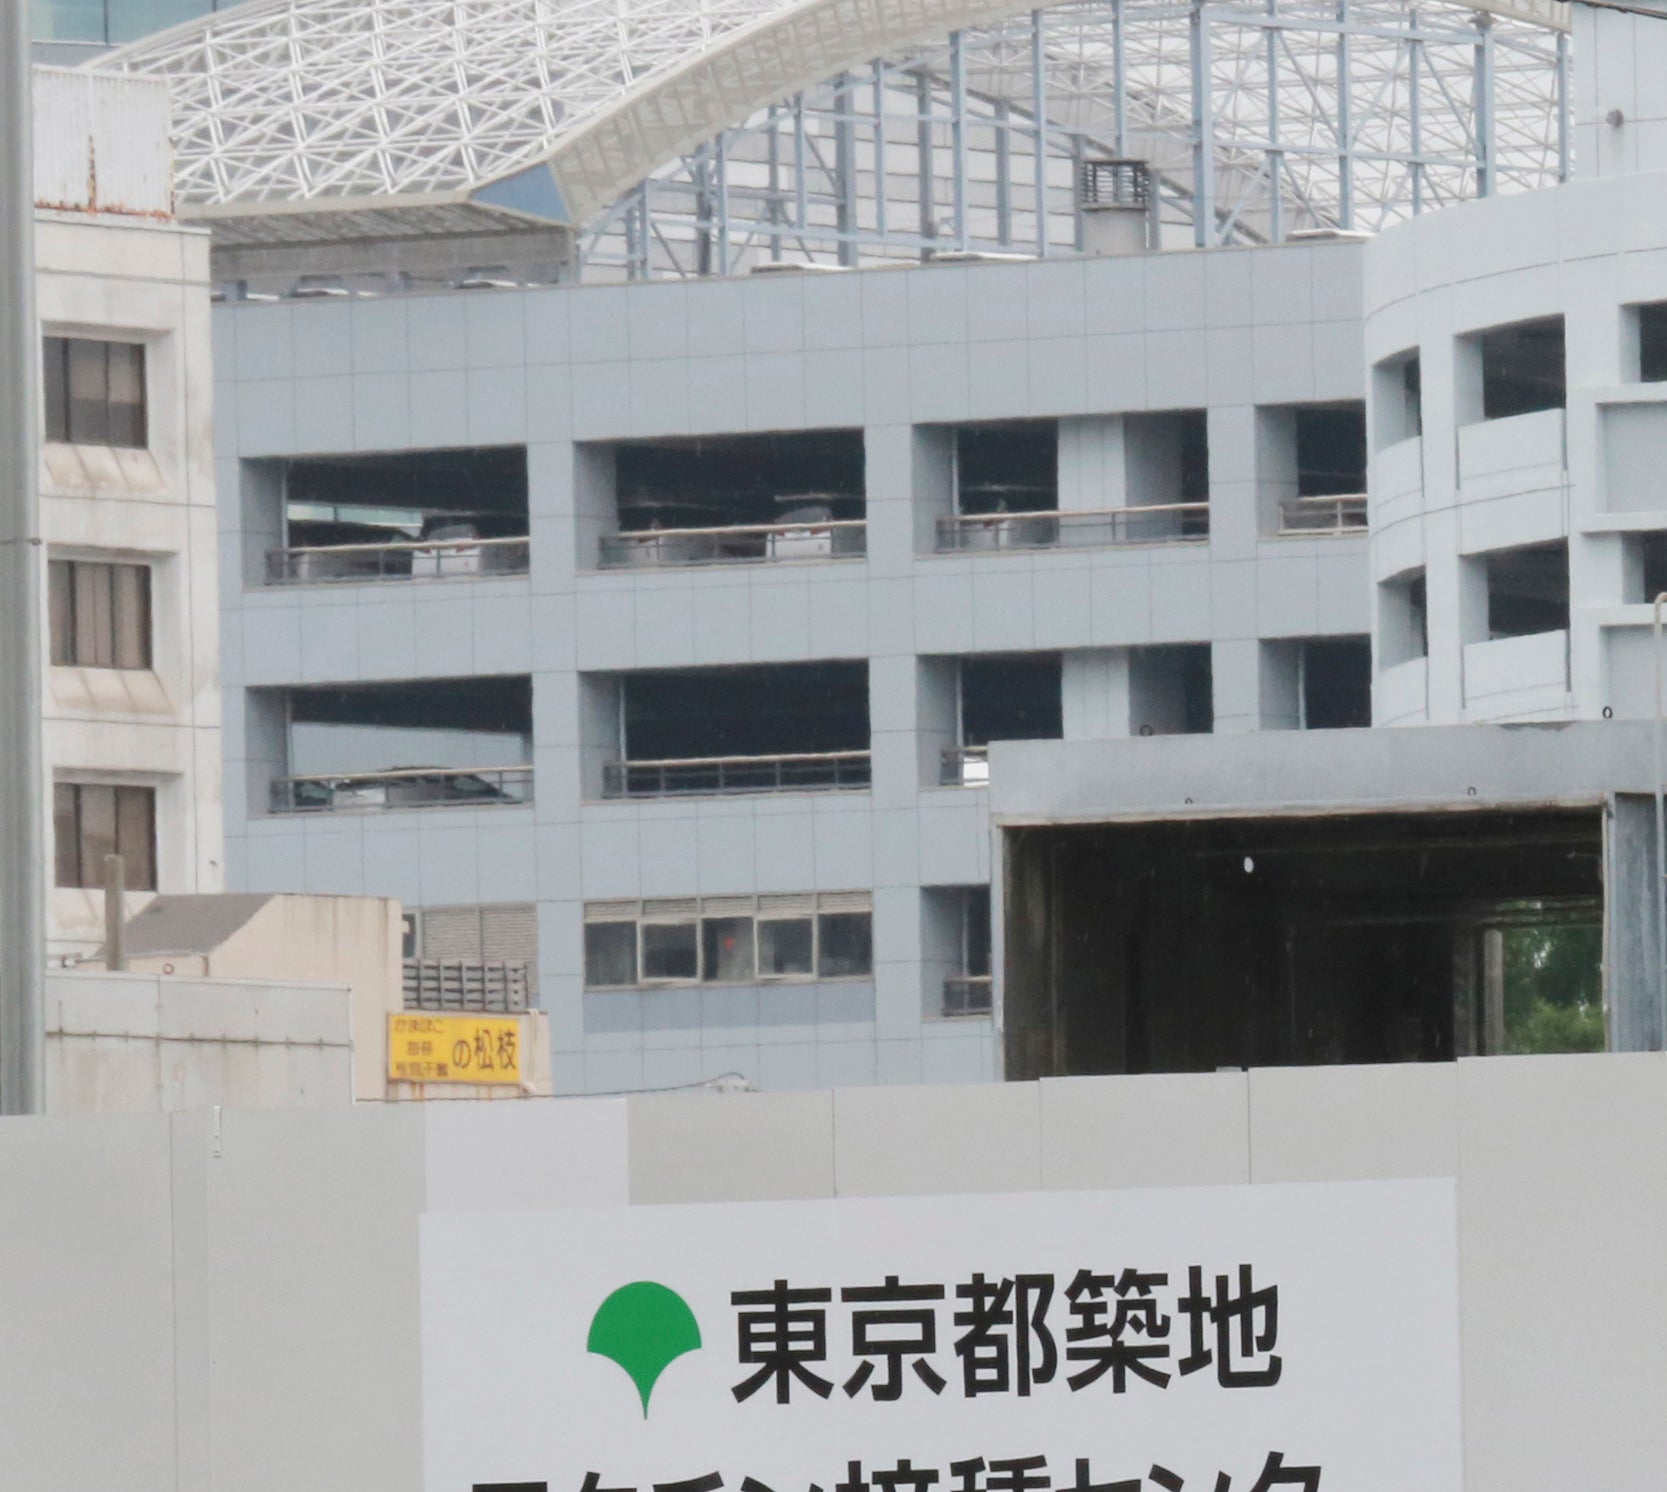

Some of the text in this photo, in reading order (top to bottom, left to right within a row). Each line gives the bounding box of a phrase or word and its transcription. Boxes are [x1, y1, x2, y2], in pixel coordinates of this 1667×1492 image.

[730, 1263, 1282, 1405] 東京都築地
